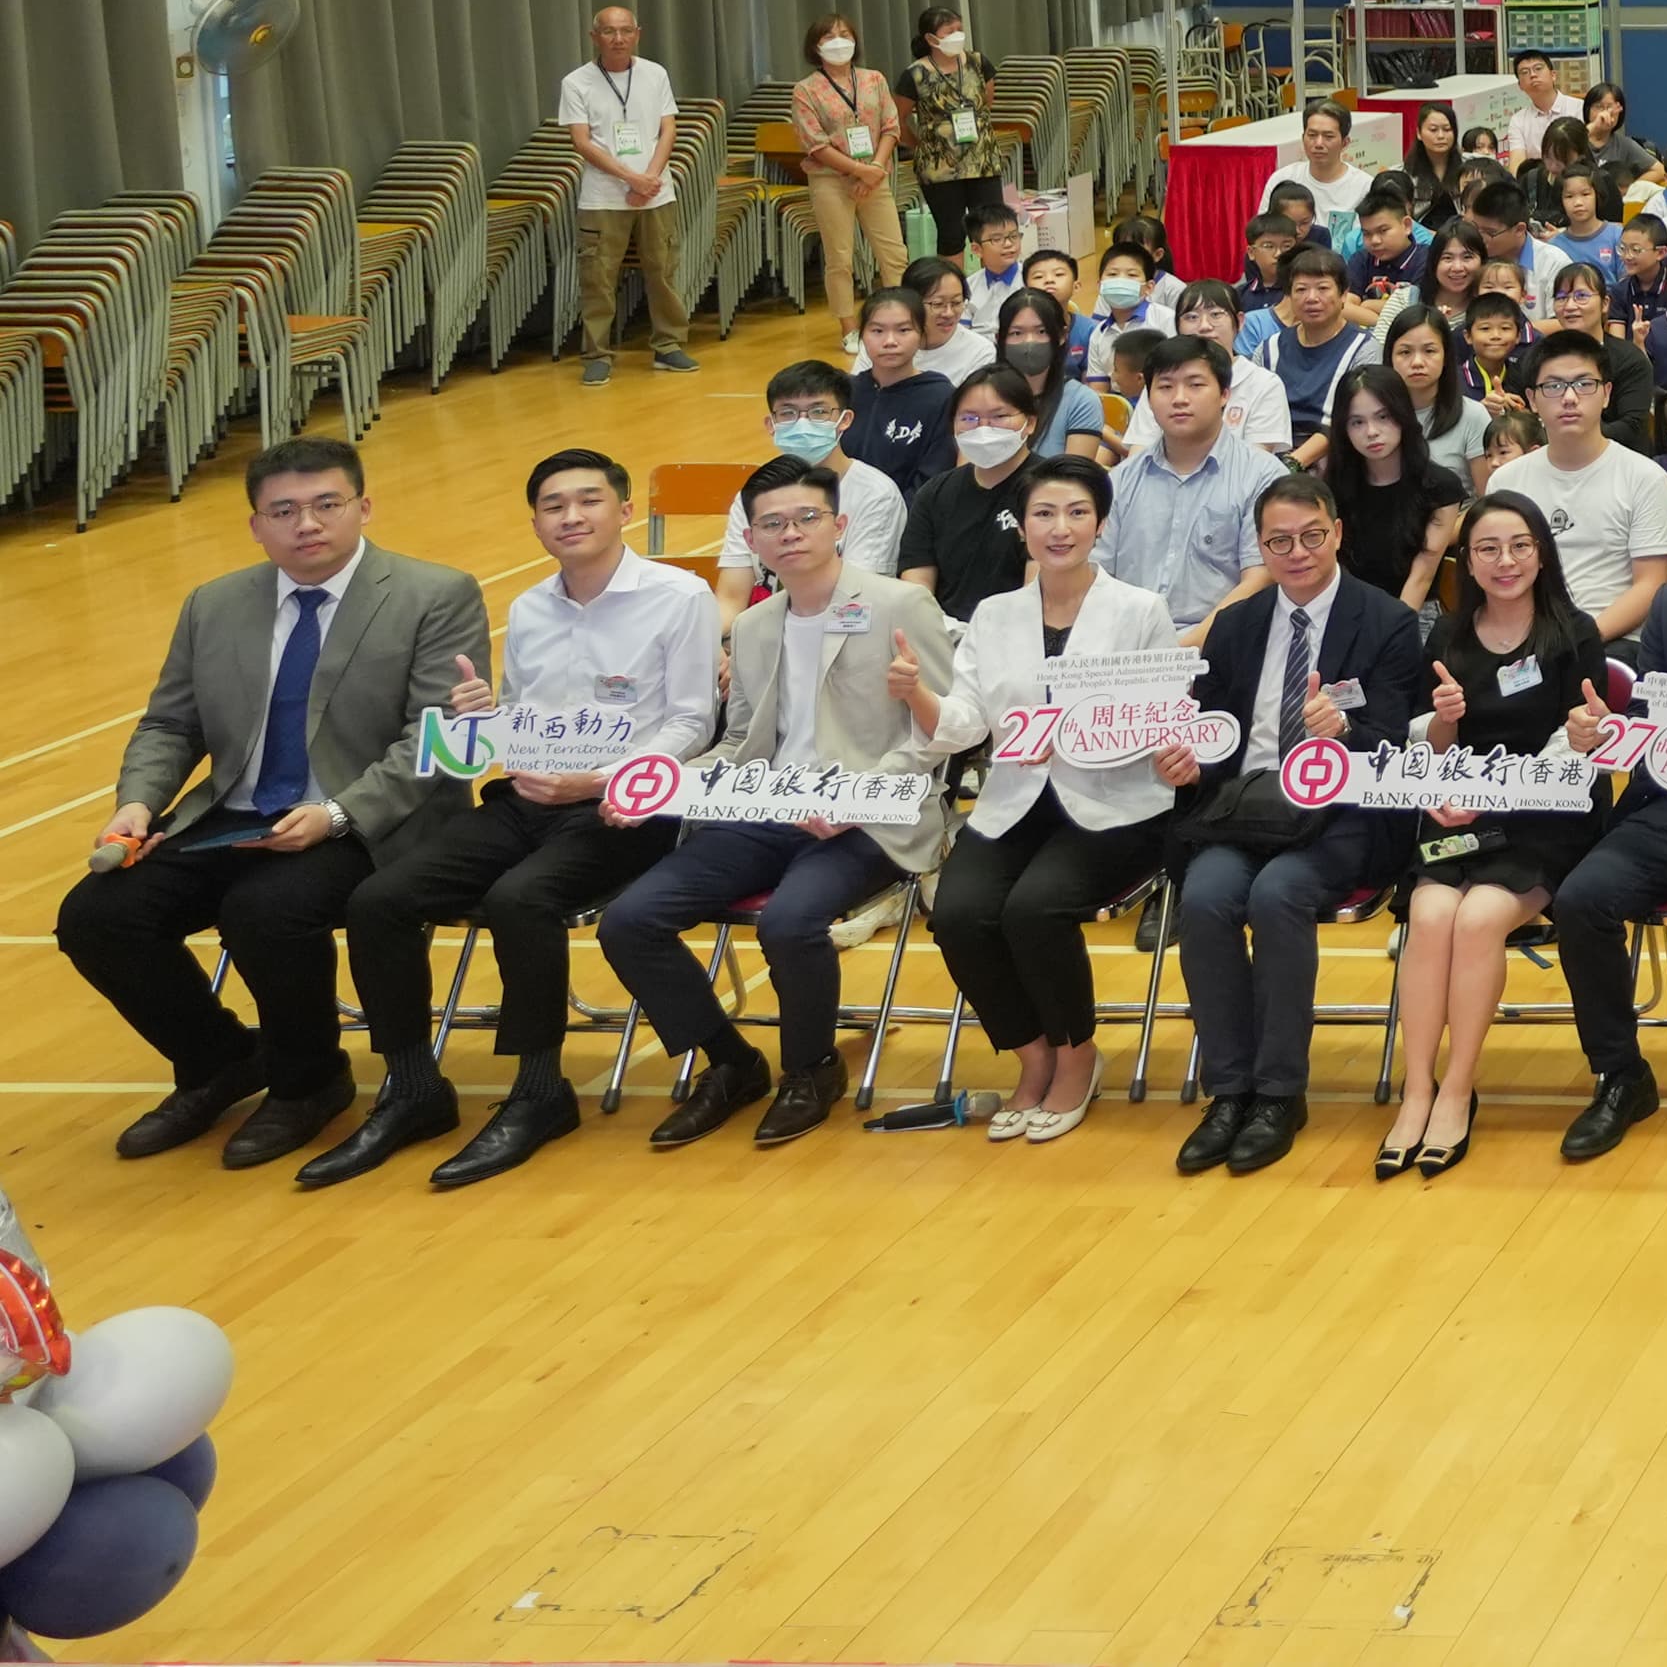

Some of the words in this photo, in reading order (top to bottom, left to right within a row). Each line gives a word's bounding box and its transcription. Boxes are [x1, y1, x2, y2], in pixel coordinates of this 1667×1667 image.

[1047, 651, 1196, 669] 中華人民共和國香港特別行政區
[1091, 699, 1195, 728] 周年紀念
[512, 708, 633, 742] 新西動力
[1071, 723, 1224, 753] ANNIVERSARY
[508, 743, 540, 754] New
[545, 743, 629, 755] Territories
[507, 759, 540, 770] West
[544, 759, 593, 770] Power
[1362, 791, 1415, 806] BANK
[1419, 793, 1443, 806] OF
[1449, 795, 1508, 808] CHINA
[687, 805, 742, 818] BANK
[748, 807, 770, 819] OF
[774, 807, 835, 822] CHINA
